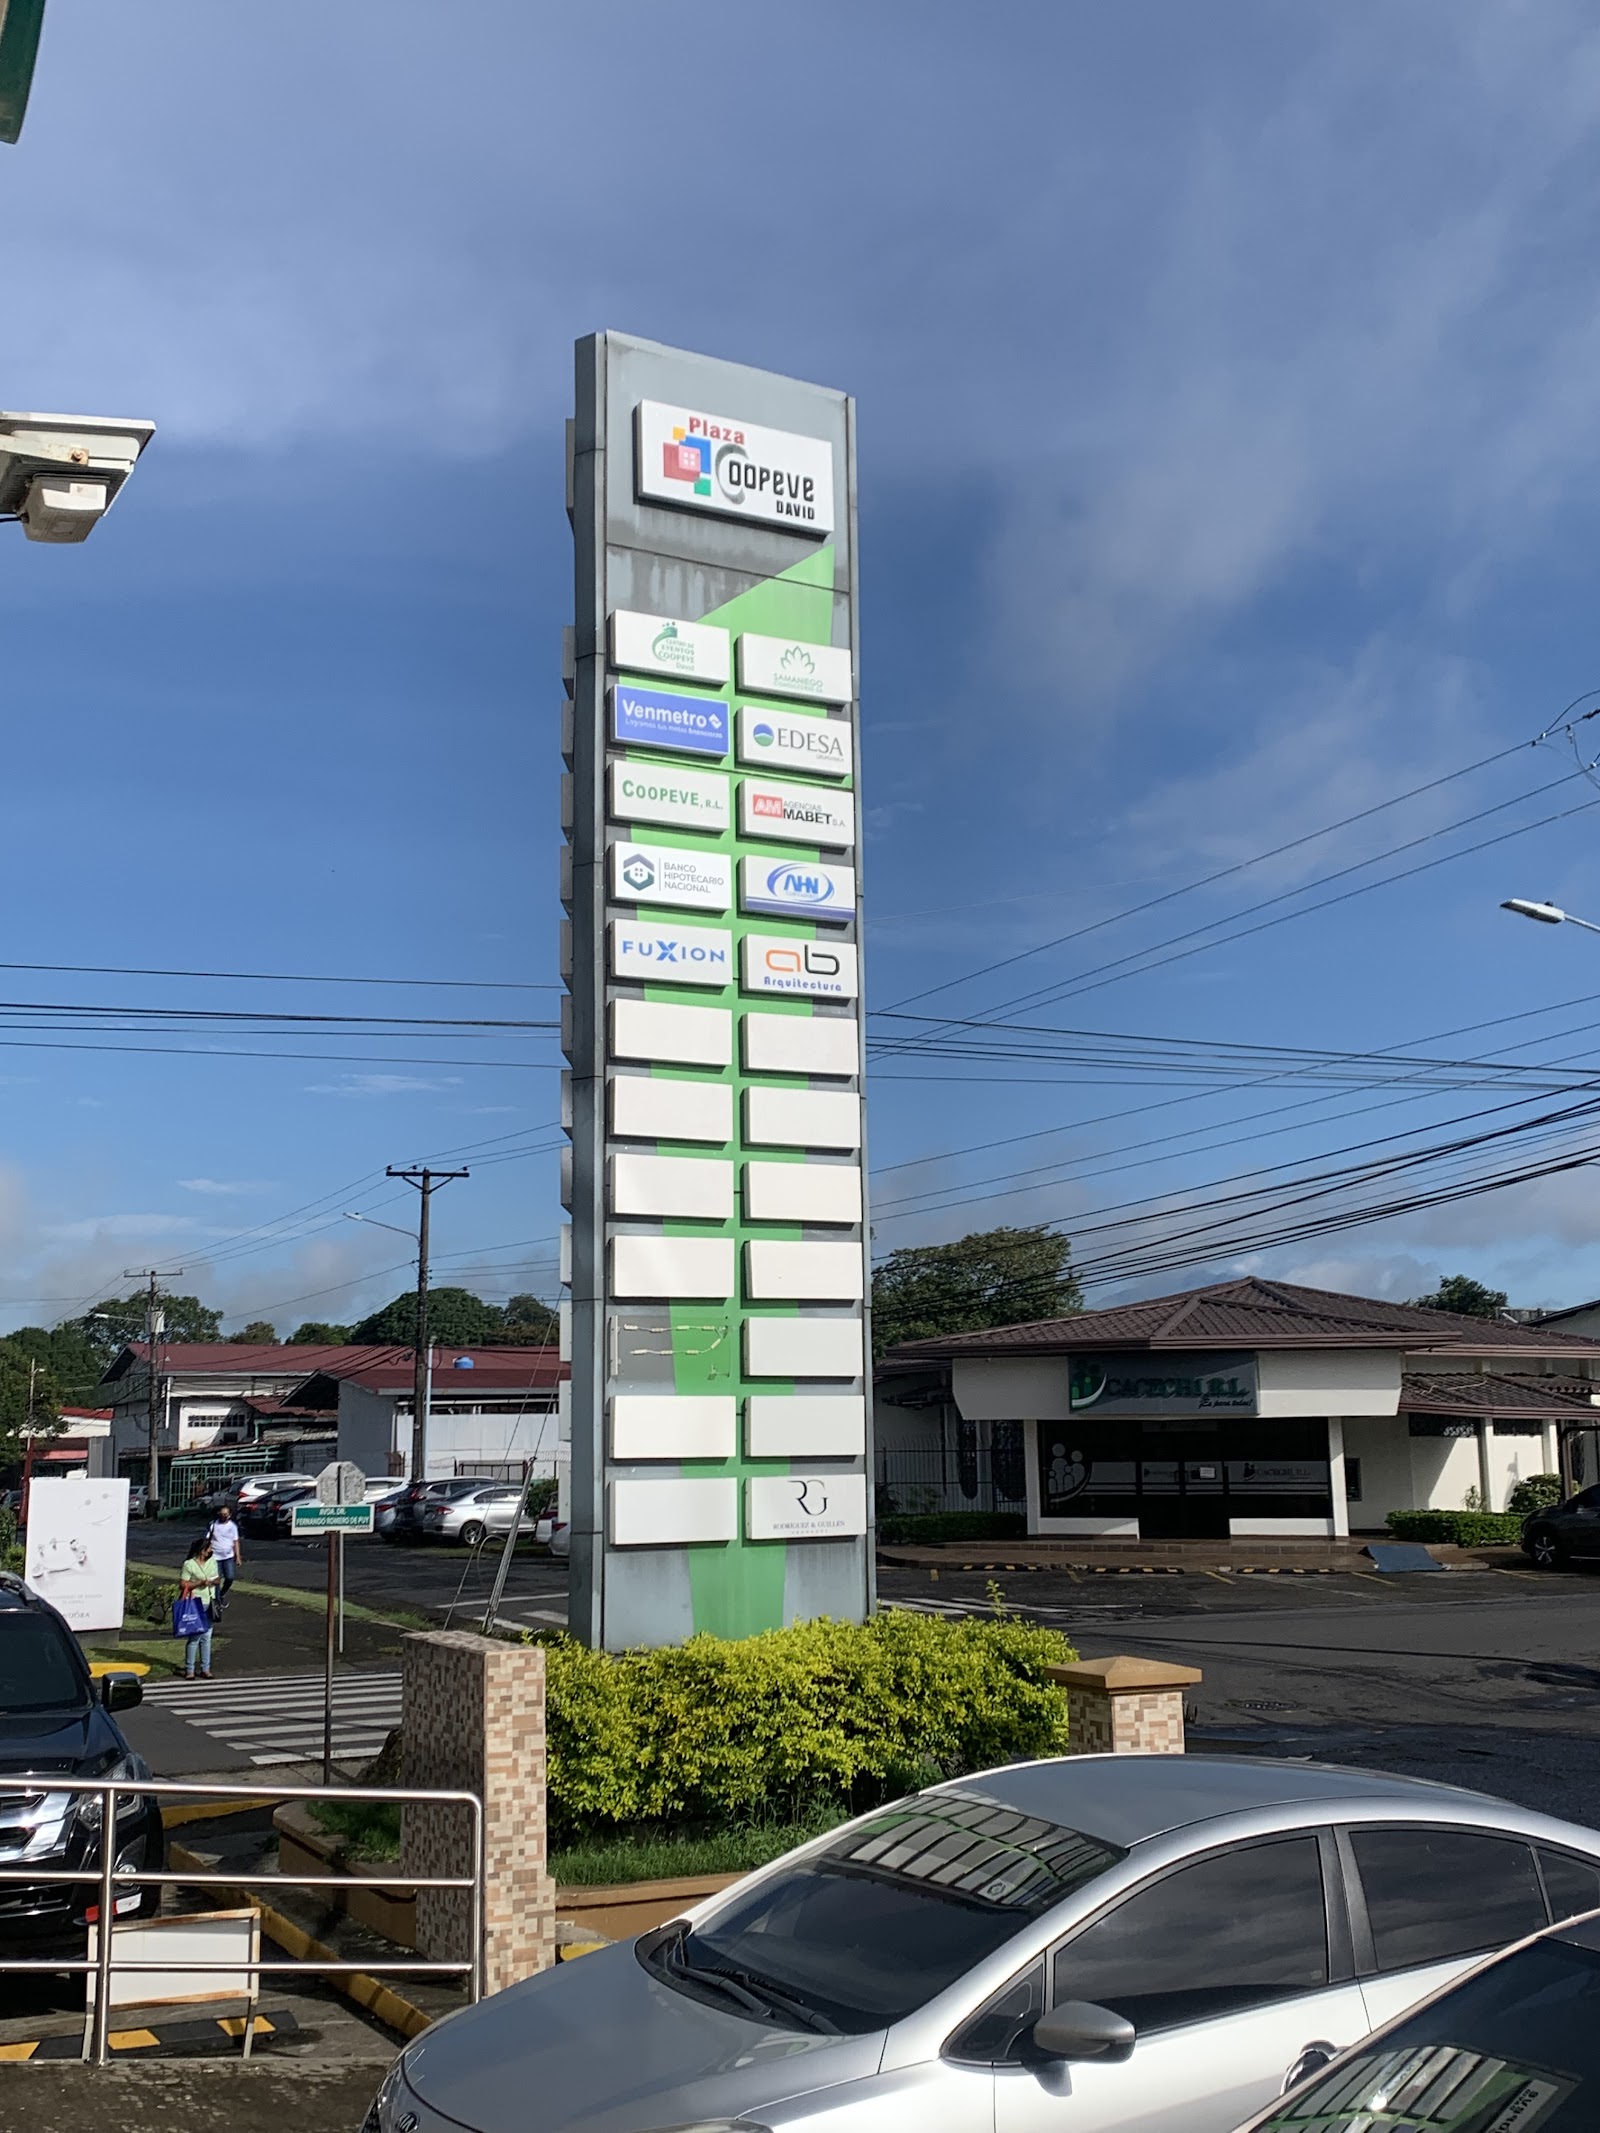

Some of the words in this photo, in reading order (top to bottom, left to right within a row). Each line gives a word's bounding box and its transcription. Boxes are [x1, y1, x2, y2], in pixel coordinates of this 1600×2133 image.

[688, 416, 745, 446] Plaza
[776, 500, 815, 520] DAVID
[658, 651, 695, 664] COOPEVE
[661, 644, 695, 656] EVENTOS
[622, 698, 707, 729] Venmetro
[777, 727, 844, 757] EDESA
[705, 799, 724, 810] R.L.
[754, 798, 782, 815] AM
[783, 800, 823, 812] AGENCIAS
[783, 808, 832, 825] MABET
[663, 861, 697, 874] BANCO
[663, 871, 725, 886] HIPOTECARIO
[664, 881, 711, 894] NACIONAL
[763, 975, 842, 992] Arquitectura
[296, 1517, 326, 1526] FERNANDO
[326, 1516, 350, 1525] ROMERO
[350, 1516, 358, 1525] DE
